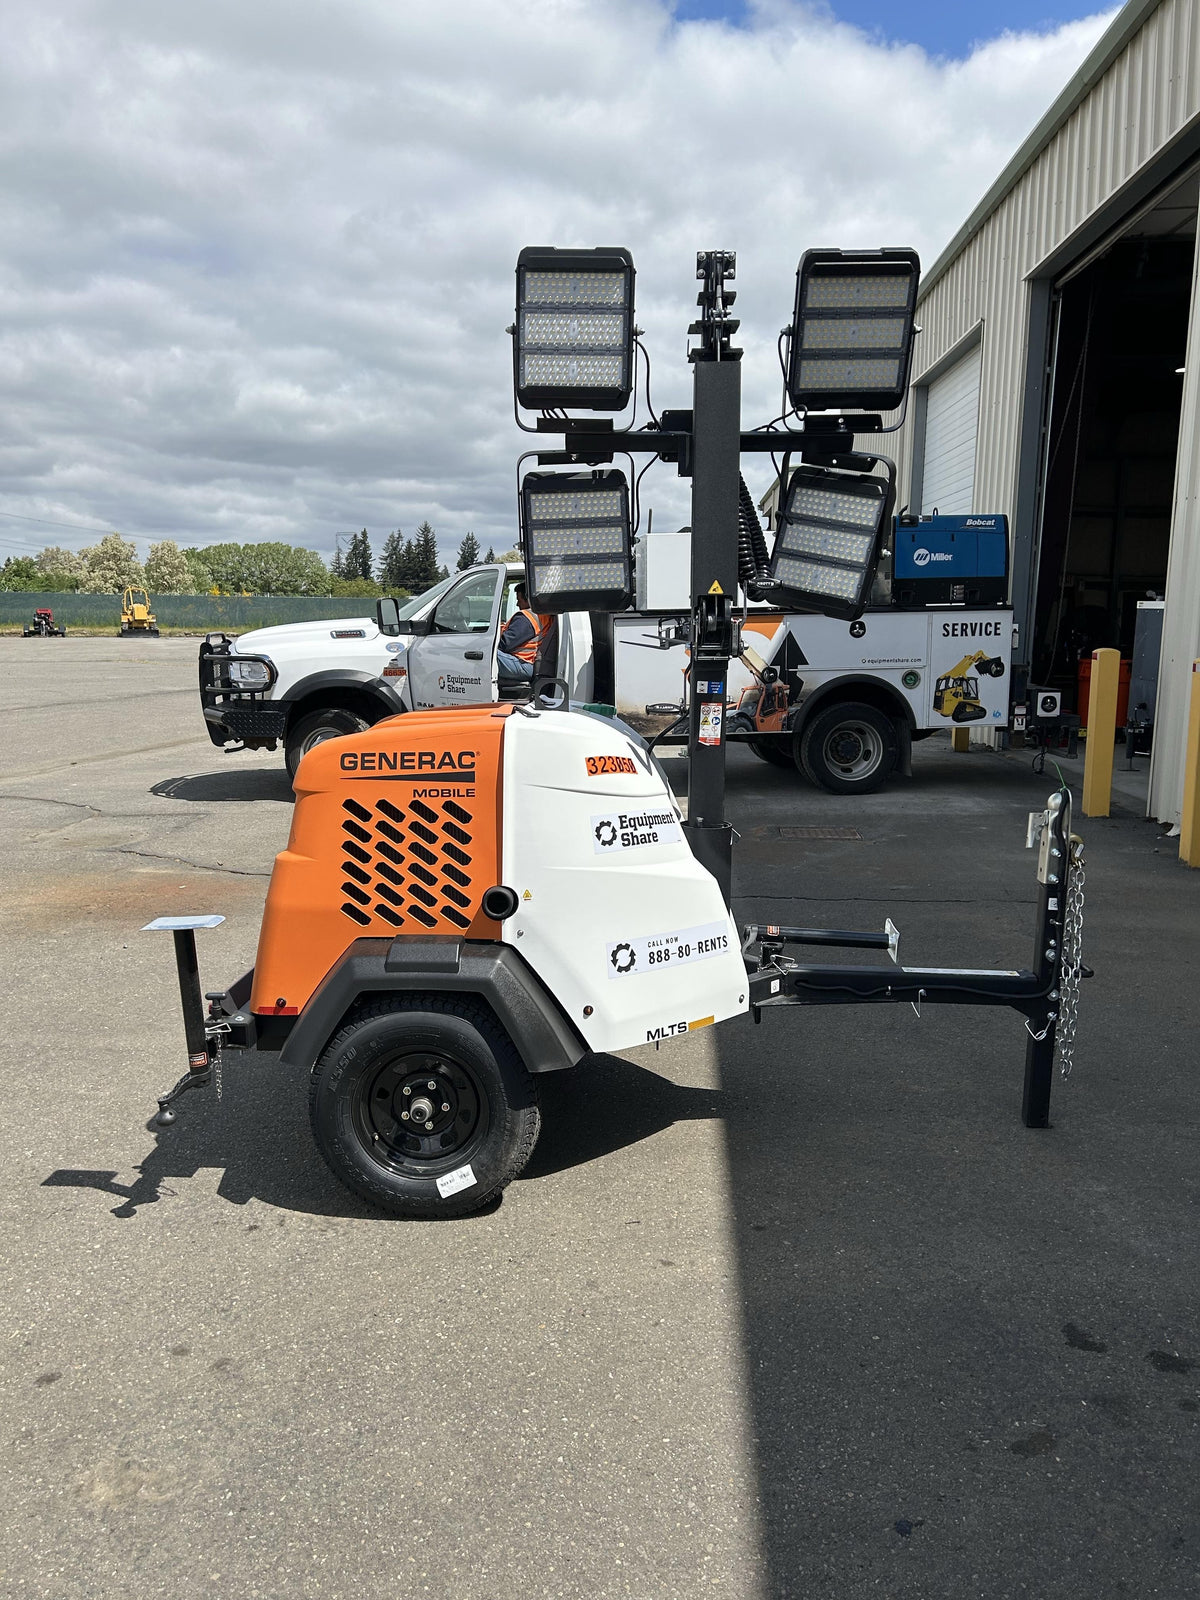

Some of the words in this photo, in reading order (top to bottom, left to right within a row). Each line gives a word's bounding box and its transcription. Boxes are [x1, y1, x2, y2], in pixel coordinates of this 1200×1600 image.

[966, 518, 996, 526] Bobcat
[930, 553, 953, 561] Miller
[942, 621, 1002, 637] SERVICE
[447, 674, 481, 686] Equipment
[447, 685, 466, 694] Share
[340, 751, 475, 771] GENERAC
[587, 756, 637, 774] 323050
[413, 788, 475, 798] MOBILE
[618, 811, 676, 831] Equipment
[620, 832, 659, 847] Share
[647, 940, 663, 948] CALL
[665, 936, 679, 944] NOW
[648, 935, 728, 965] 888-80-RENTS
[646, 1021, 687, 1042] MLTS
